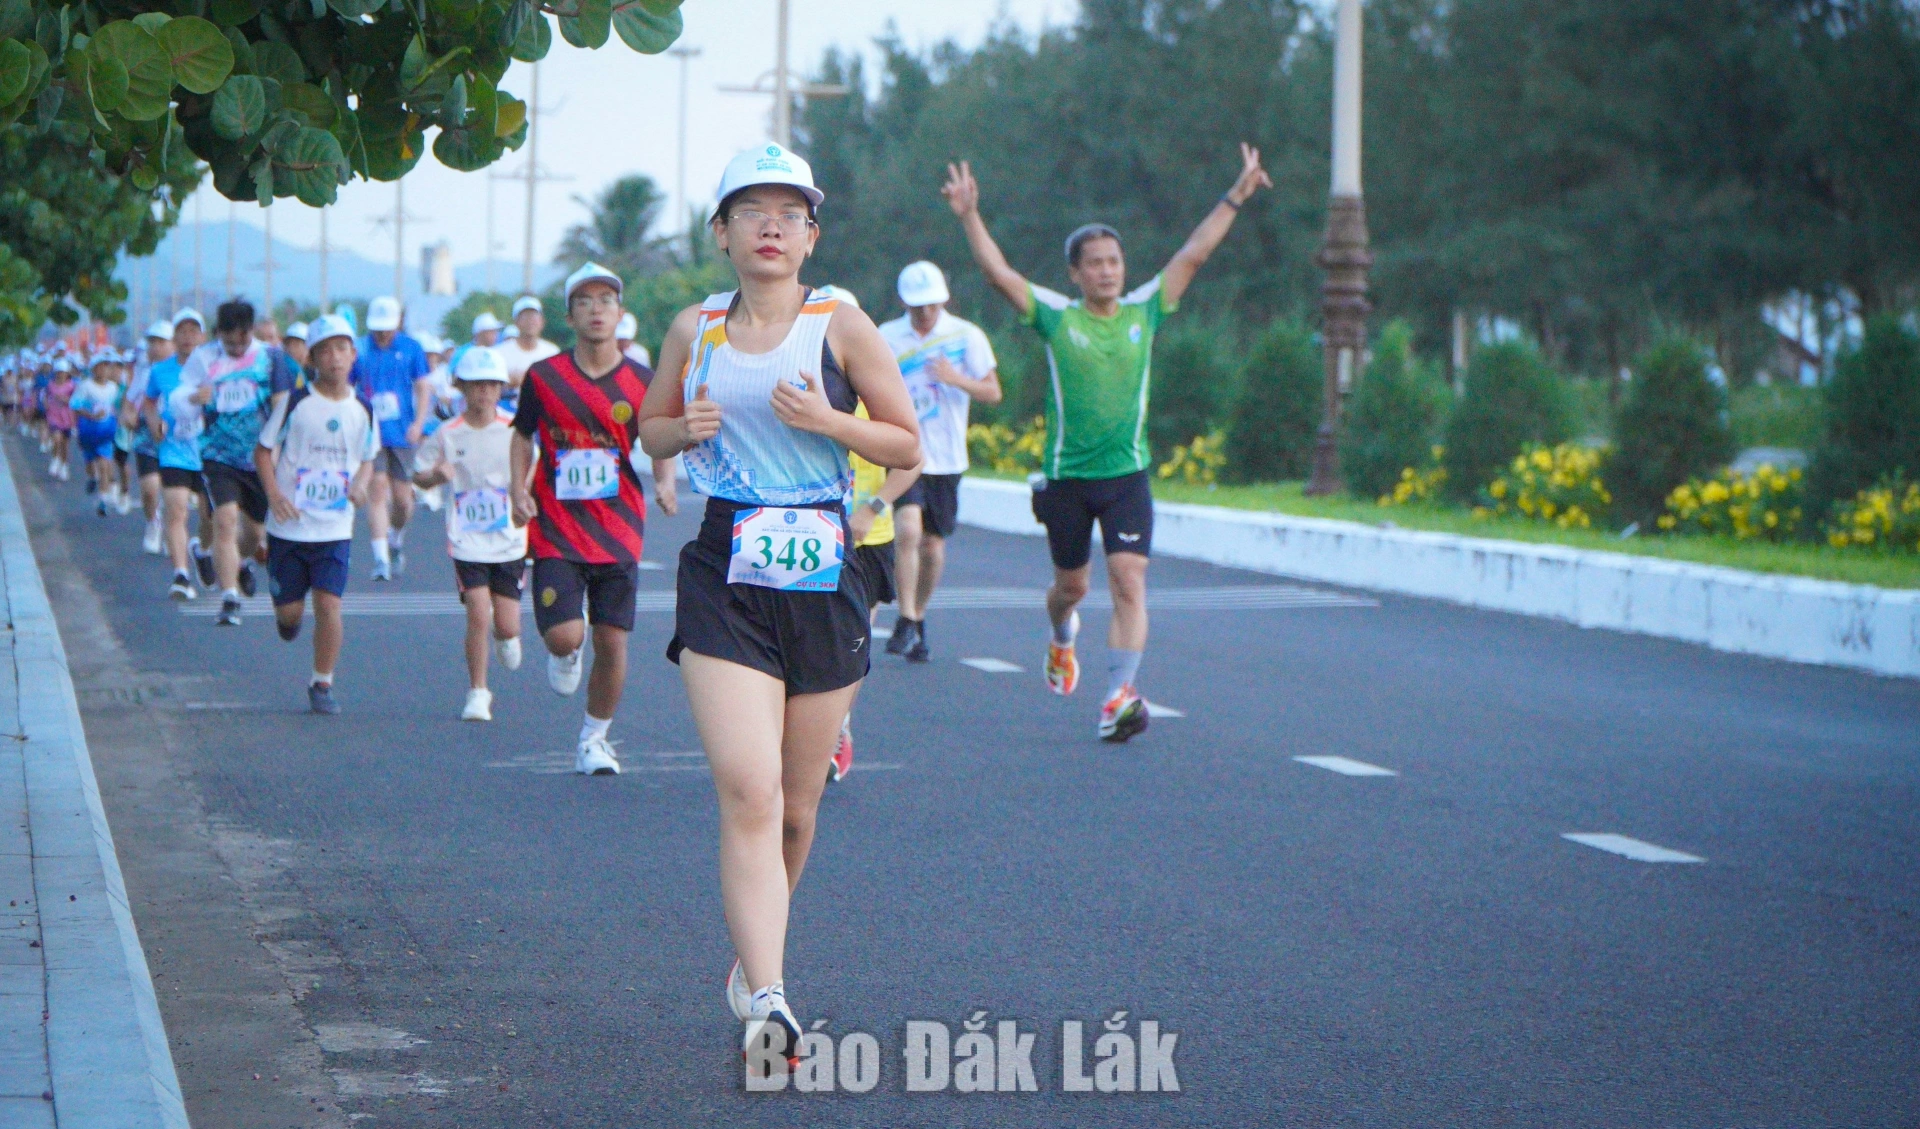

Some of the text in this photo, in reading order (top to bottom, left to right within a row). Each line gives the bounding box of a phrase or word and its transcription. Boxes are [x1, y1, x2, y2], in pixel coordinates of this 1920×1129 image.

[568, 466, 606, 486] 014
[306, 483, 338, 501] 020
[466, 503, 496, 522] 021
[751, 535, 822, 572] 348
